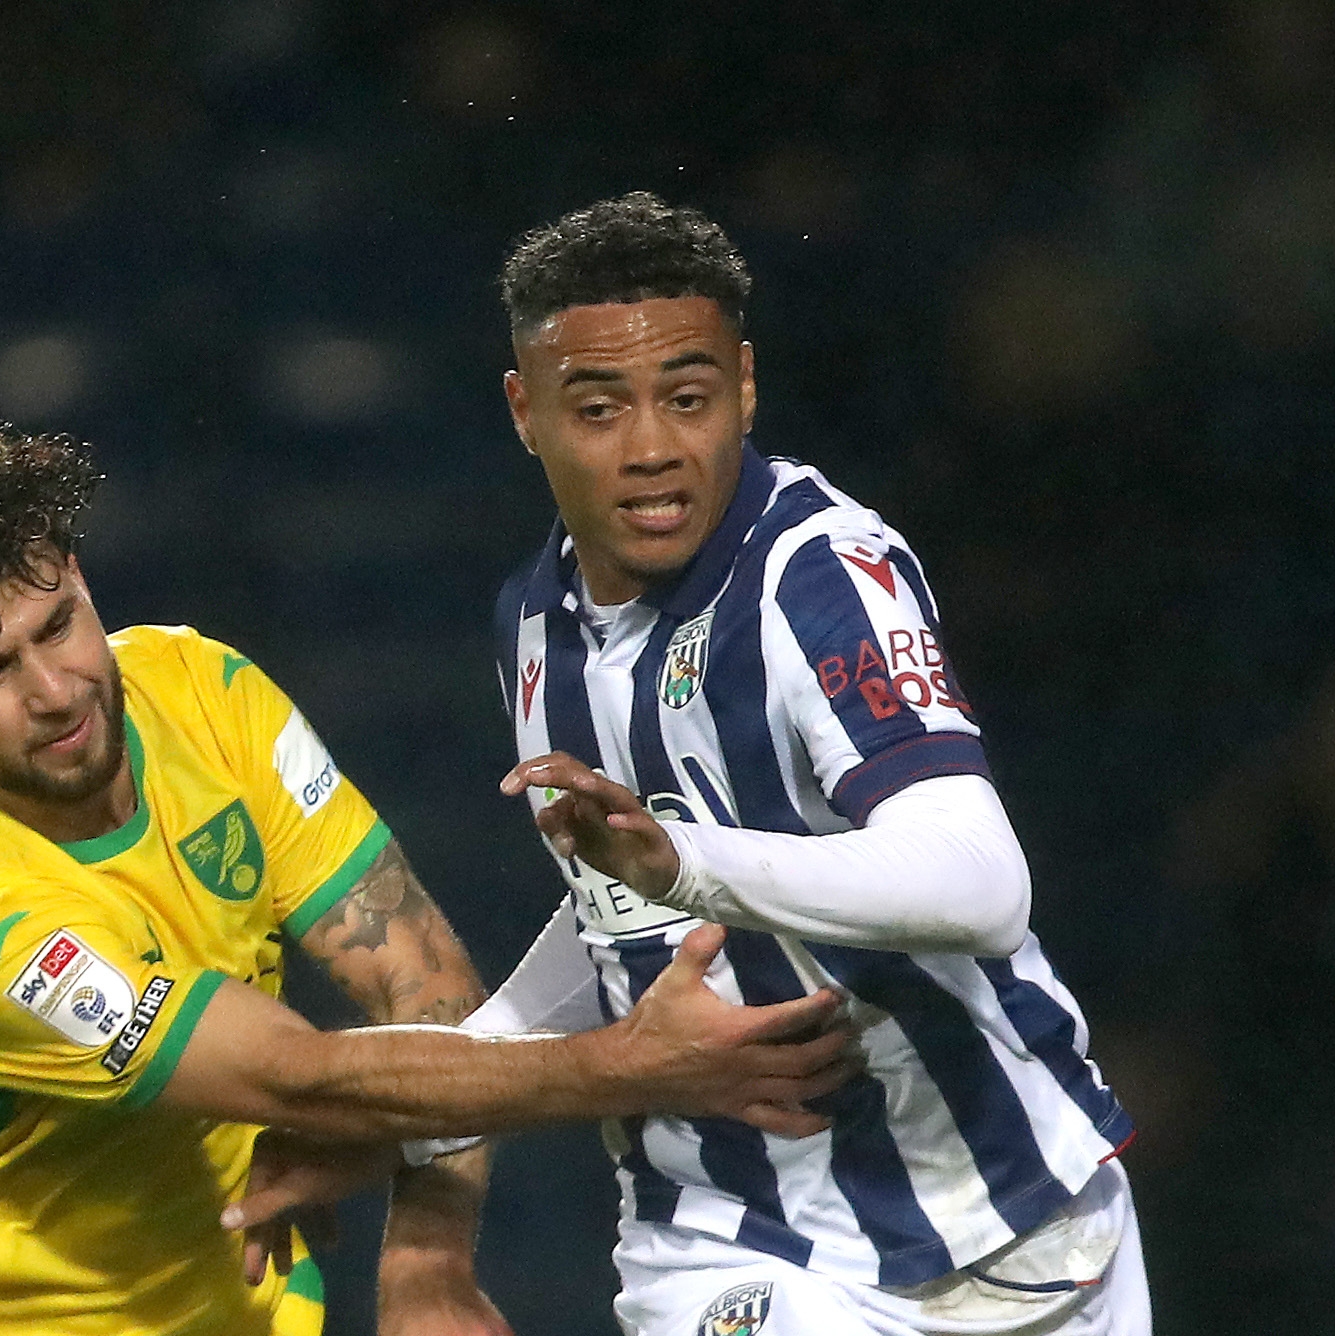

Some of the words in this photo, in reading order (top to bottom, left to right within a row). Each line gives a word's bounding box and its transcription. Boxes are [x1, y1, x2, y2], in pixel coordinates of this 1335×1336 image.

[21, 971, 48, 1005] sky
[42, 941, 75, 972] bet
[97, 1009, 124, 1035] EFL
[104, 978, 172, 1072] TGETHER
